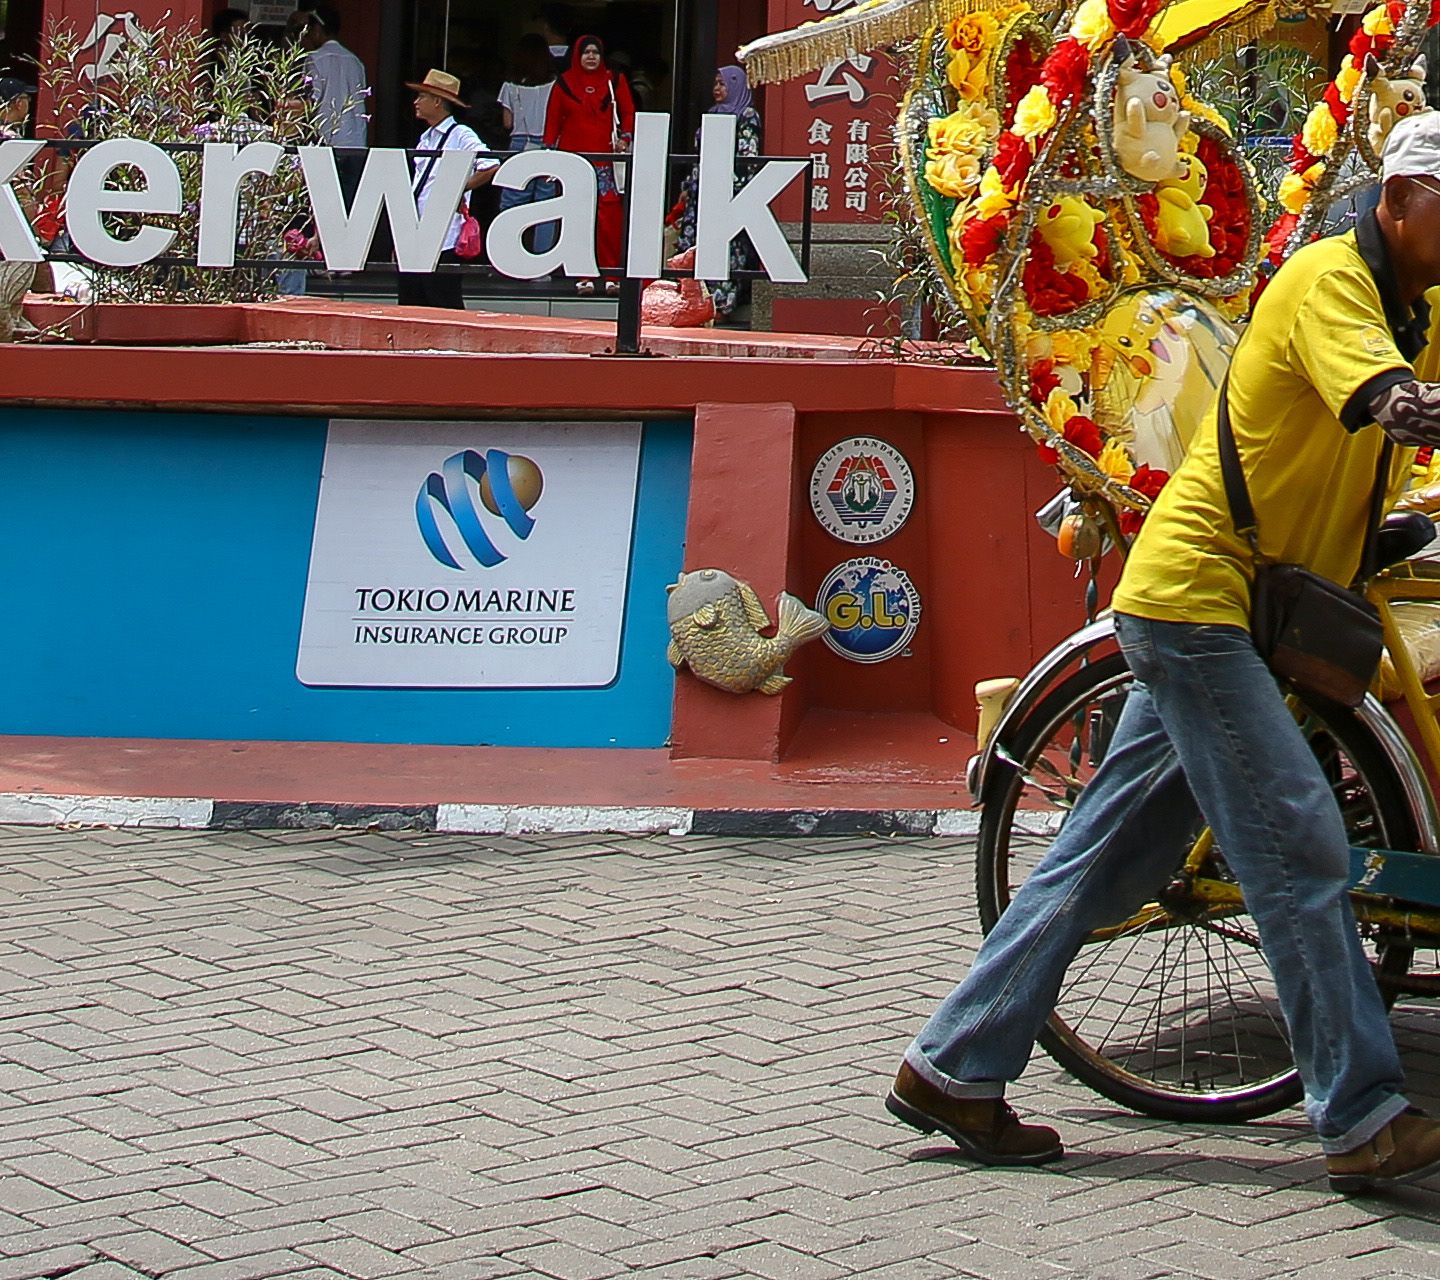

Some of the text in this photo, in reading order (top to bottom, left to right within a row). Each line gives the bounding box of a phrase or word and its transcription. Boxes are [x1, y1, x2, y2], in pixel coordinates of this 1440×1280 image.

[843, 118, 871, 213] 有限公司
[812, 438, 912, 487] MAJLIS BANDARAYA
[812, 496, 911, 542] MELAKA BERSEJARAH
[354, 587, 578, 613] TOKIO MARINE
[825, 591, 908, 632] G.L.
[354, 624, 569, 646] INSURANCE GROUP
